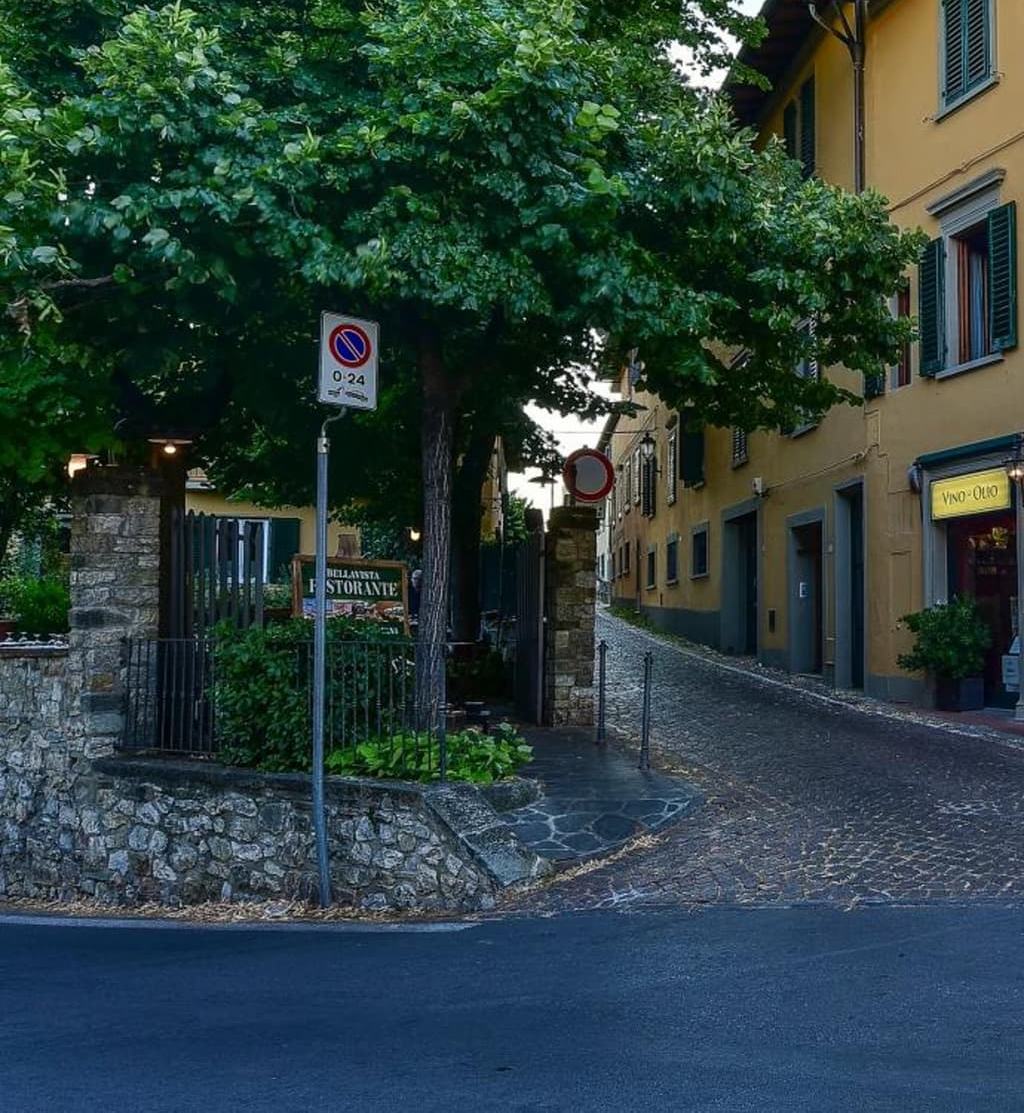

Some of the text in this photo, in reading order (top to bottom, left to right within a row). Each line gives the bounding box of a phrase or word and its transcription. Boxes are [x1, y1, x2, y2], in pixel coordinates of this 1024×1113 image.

[332, 370, 365, 386] 0-24
[942, 490, 966, 506] VINO
[973, 484, 998, 501] OLIO
[327, 568, 381, 581] BELLAVISTA
[309, 578, 398, 597] RSTORANTE
